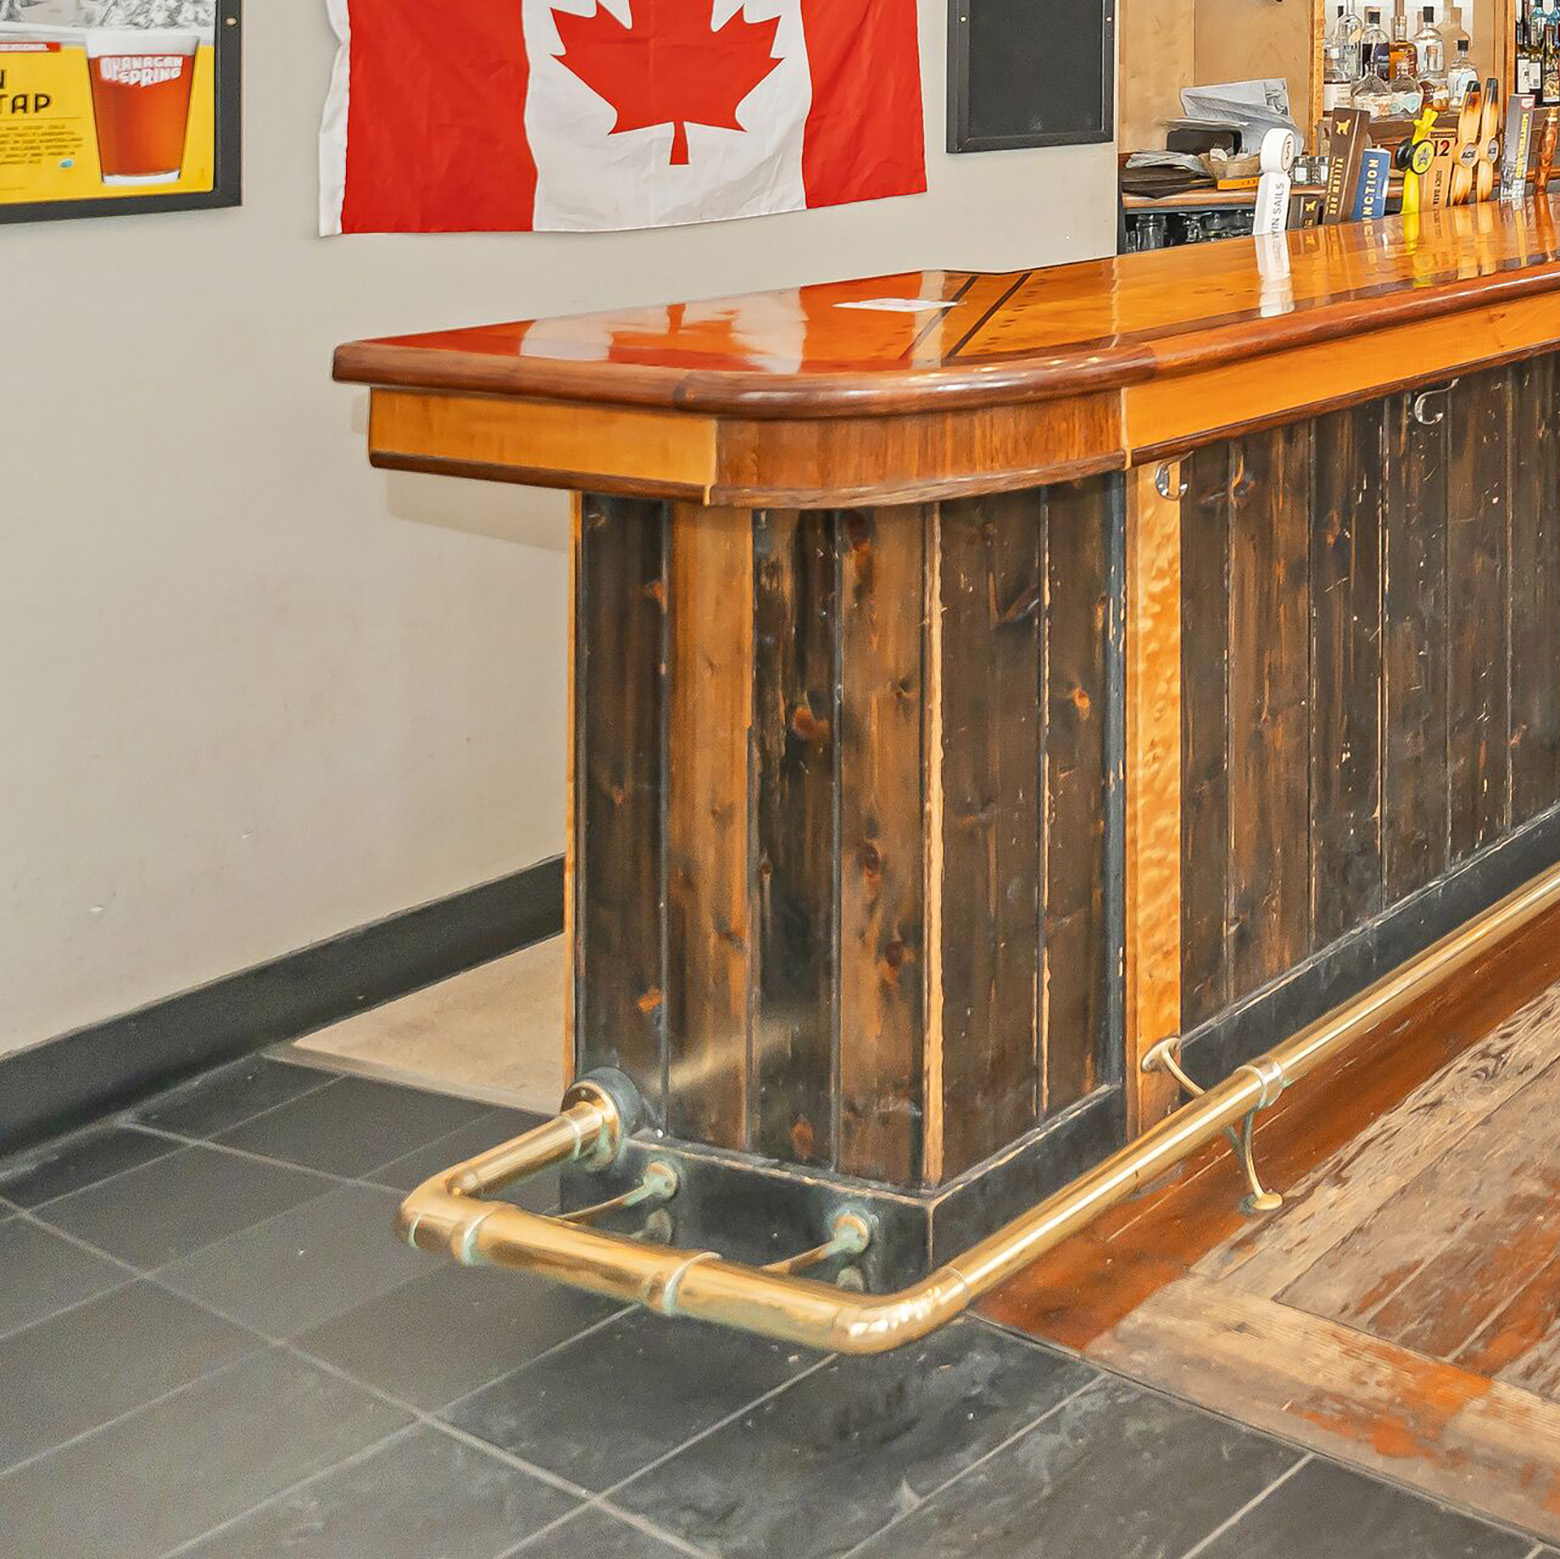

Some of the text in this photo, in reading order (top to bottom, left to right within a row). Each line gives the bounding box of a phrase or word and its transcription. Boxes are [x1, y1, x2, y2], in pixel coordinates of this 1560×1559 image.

[101, 56, 184, 82] OKANAGAN
[117, 67, 182, 88] SPRING
[1461, 150, 1476, 159] ACE
[1273, 182, 1285, 215] SAILS
